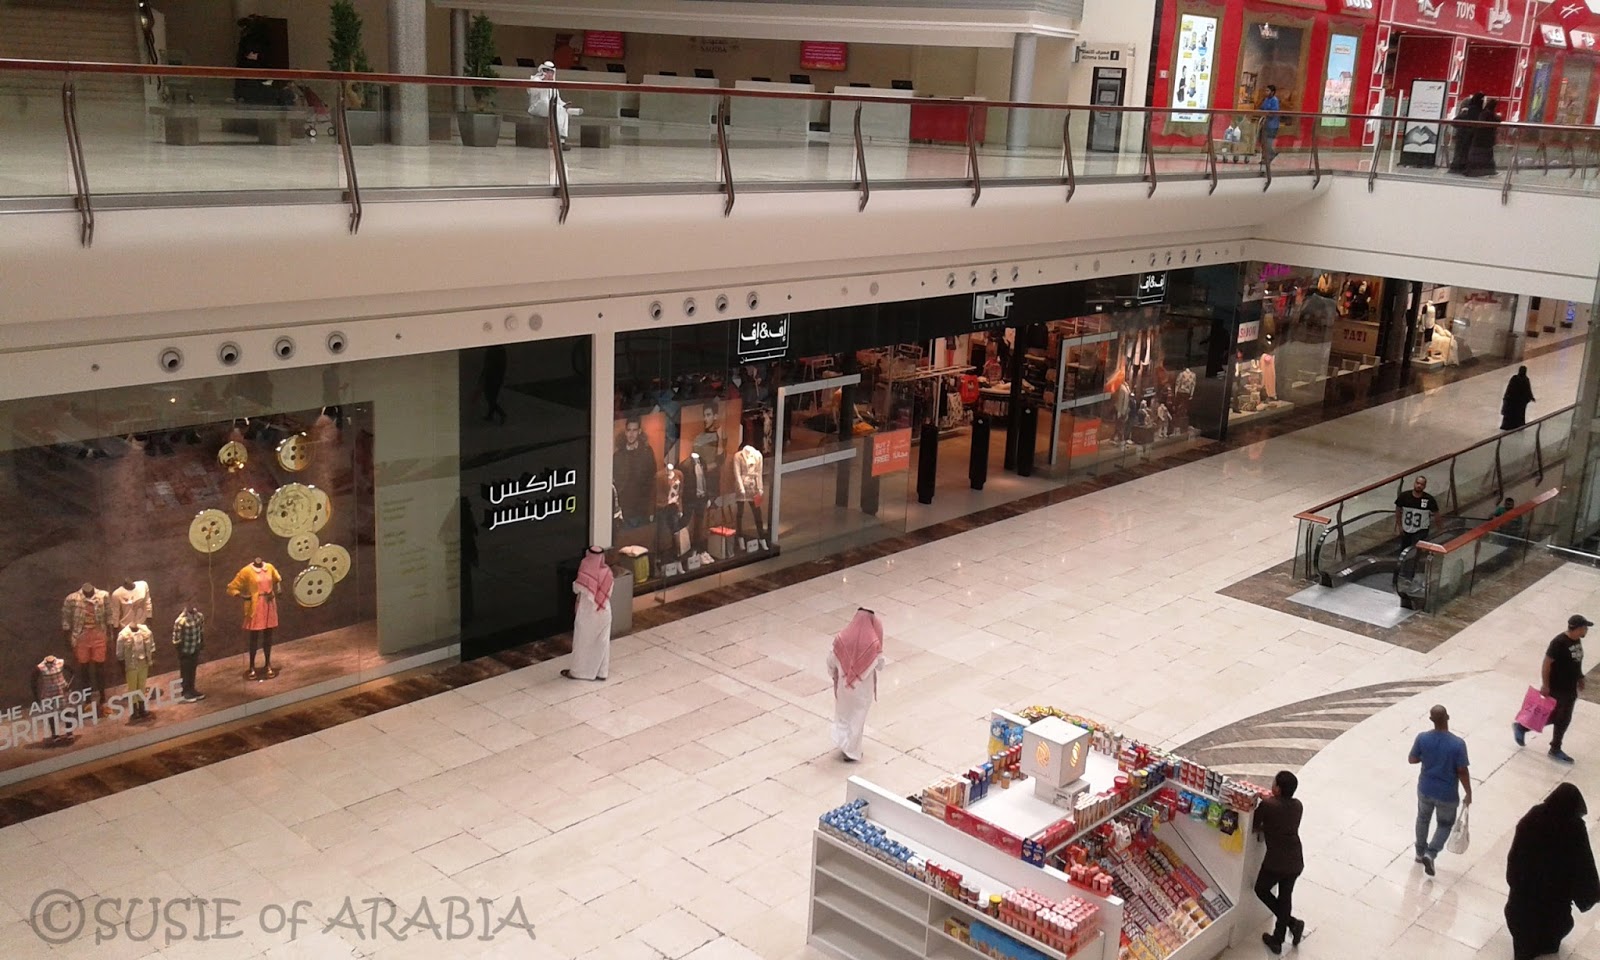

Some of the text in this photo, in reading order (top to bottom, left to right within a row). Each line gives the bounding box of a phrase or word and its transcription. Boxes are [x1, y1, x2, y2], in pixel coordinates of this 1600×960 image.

[1456, 2, 1476, 20] TOYS
[1343, 328, 1367, 342] TATI
[490, 470, 576, 504] ماركس
[1405, 512, 1422, 528] 83
[0, 687, 93, 722] HE ART OF
[0, 678, 187, 751] BRITISH STYLE
